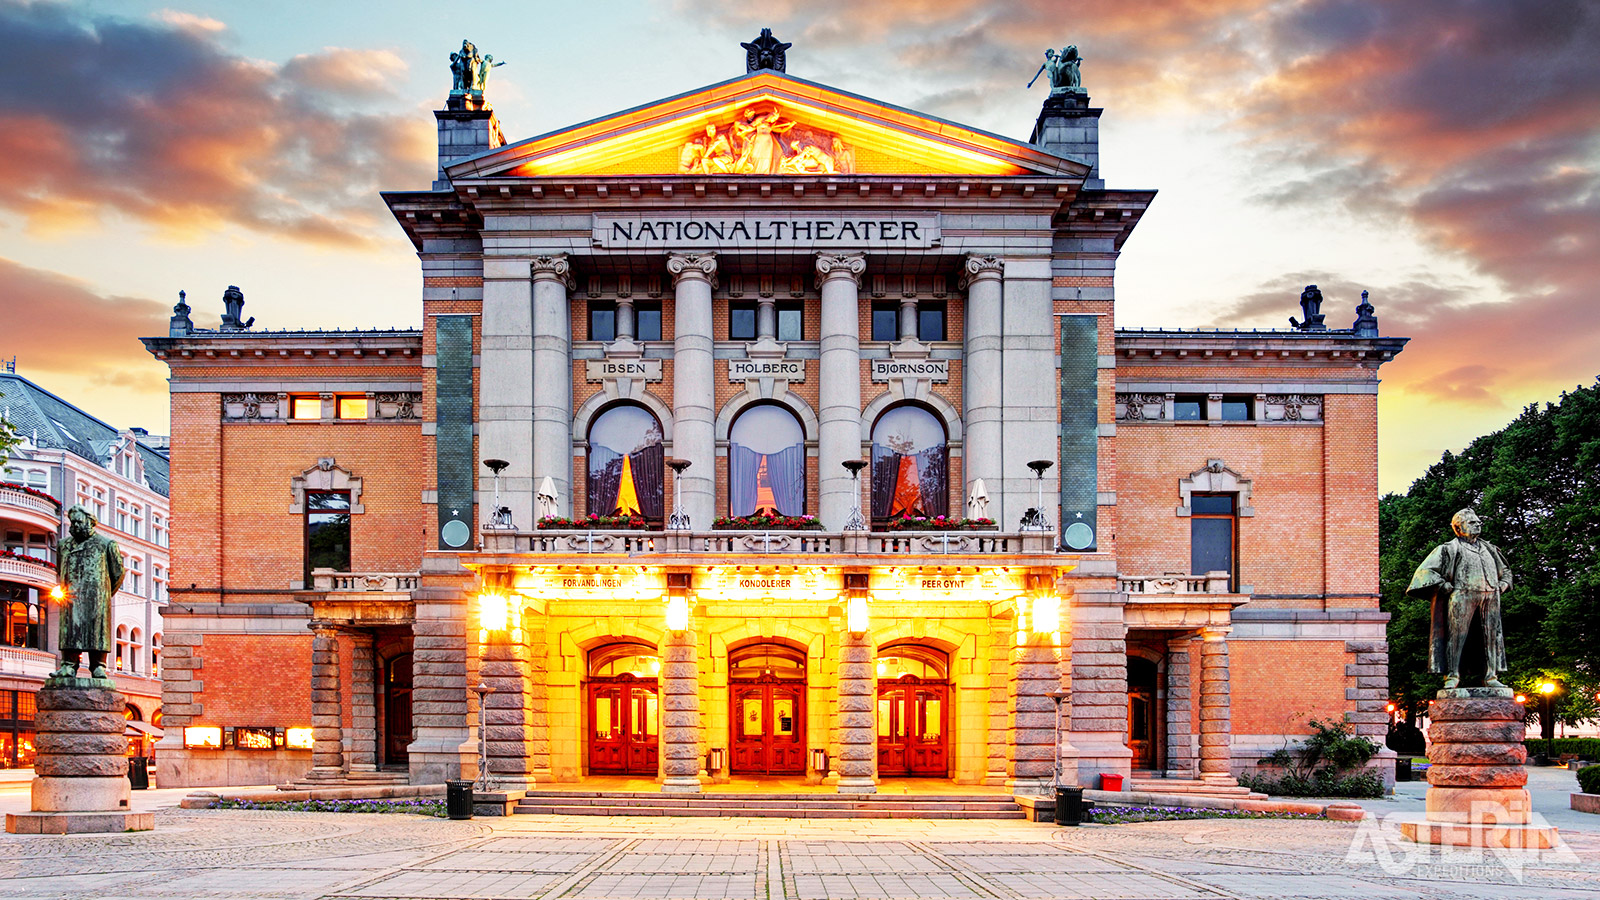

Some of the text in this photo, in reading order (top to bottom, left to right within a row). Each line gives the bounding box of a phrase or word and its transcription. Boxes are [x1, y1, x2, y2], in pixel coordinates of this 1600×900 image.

[612, 221, 921, 240] NATIONALTHEATER
[603, 364, 646, 373] IBSEN
[735, 364, 798, 373] HOLBERG
[877, 364, 944, 375] BJØRNSON
[563, 579, 622, 587] FORVANDLINGEN
[739, 579, 791, 588] KONDOLERER
[921, 580, 965, 588] PEER GYNT
